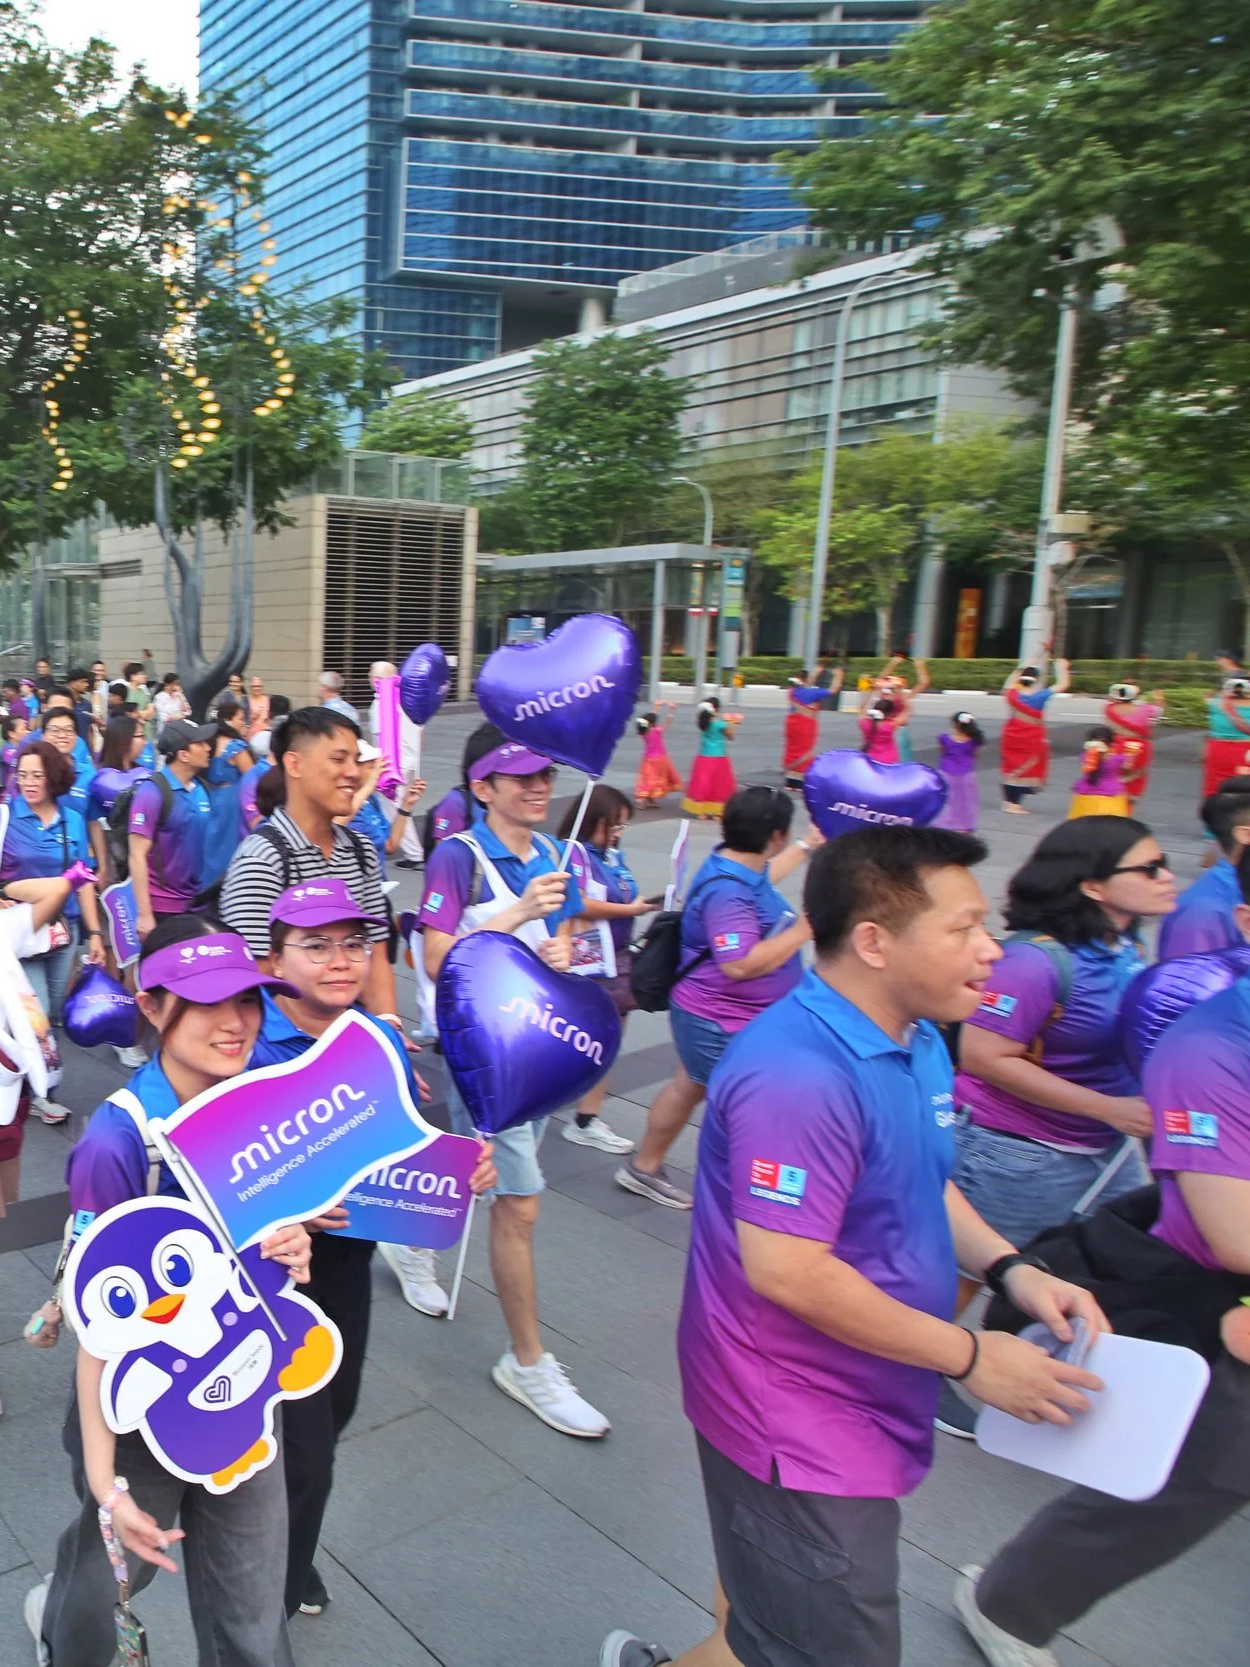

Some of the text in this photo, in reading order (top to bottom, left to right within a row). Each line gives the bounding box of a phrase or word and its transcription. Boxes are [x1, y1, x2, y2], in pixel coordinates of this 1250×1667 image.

[513, 675, 616, 722] micron
[498, 996, 605, 1067] micron
[228, 1083, 367, 1184] micron
[237, 1152, 307, 1203] Intelligence
[750, 1185, 802, 1207] LEGENDS
